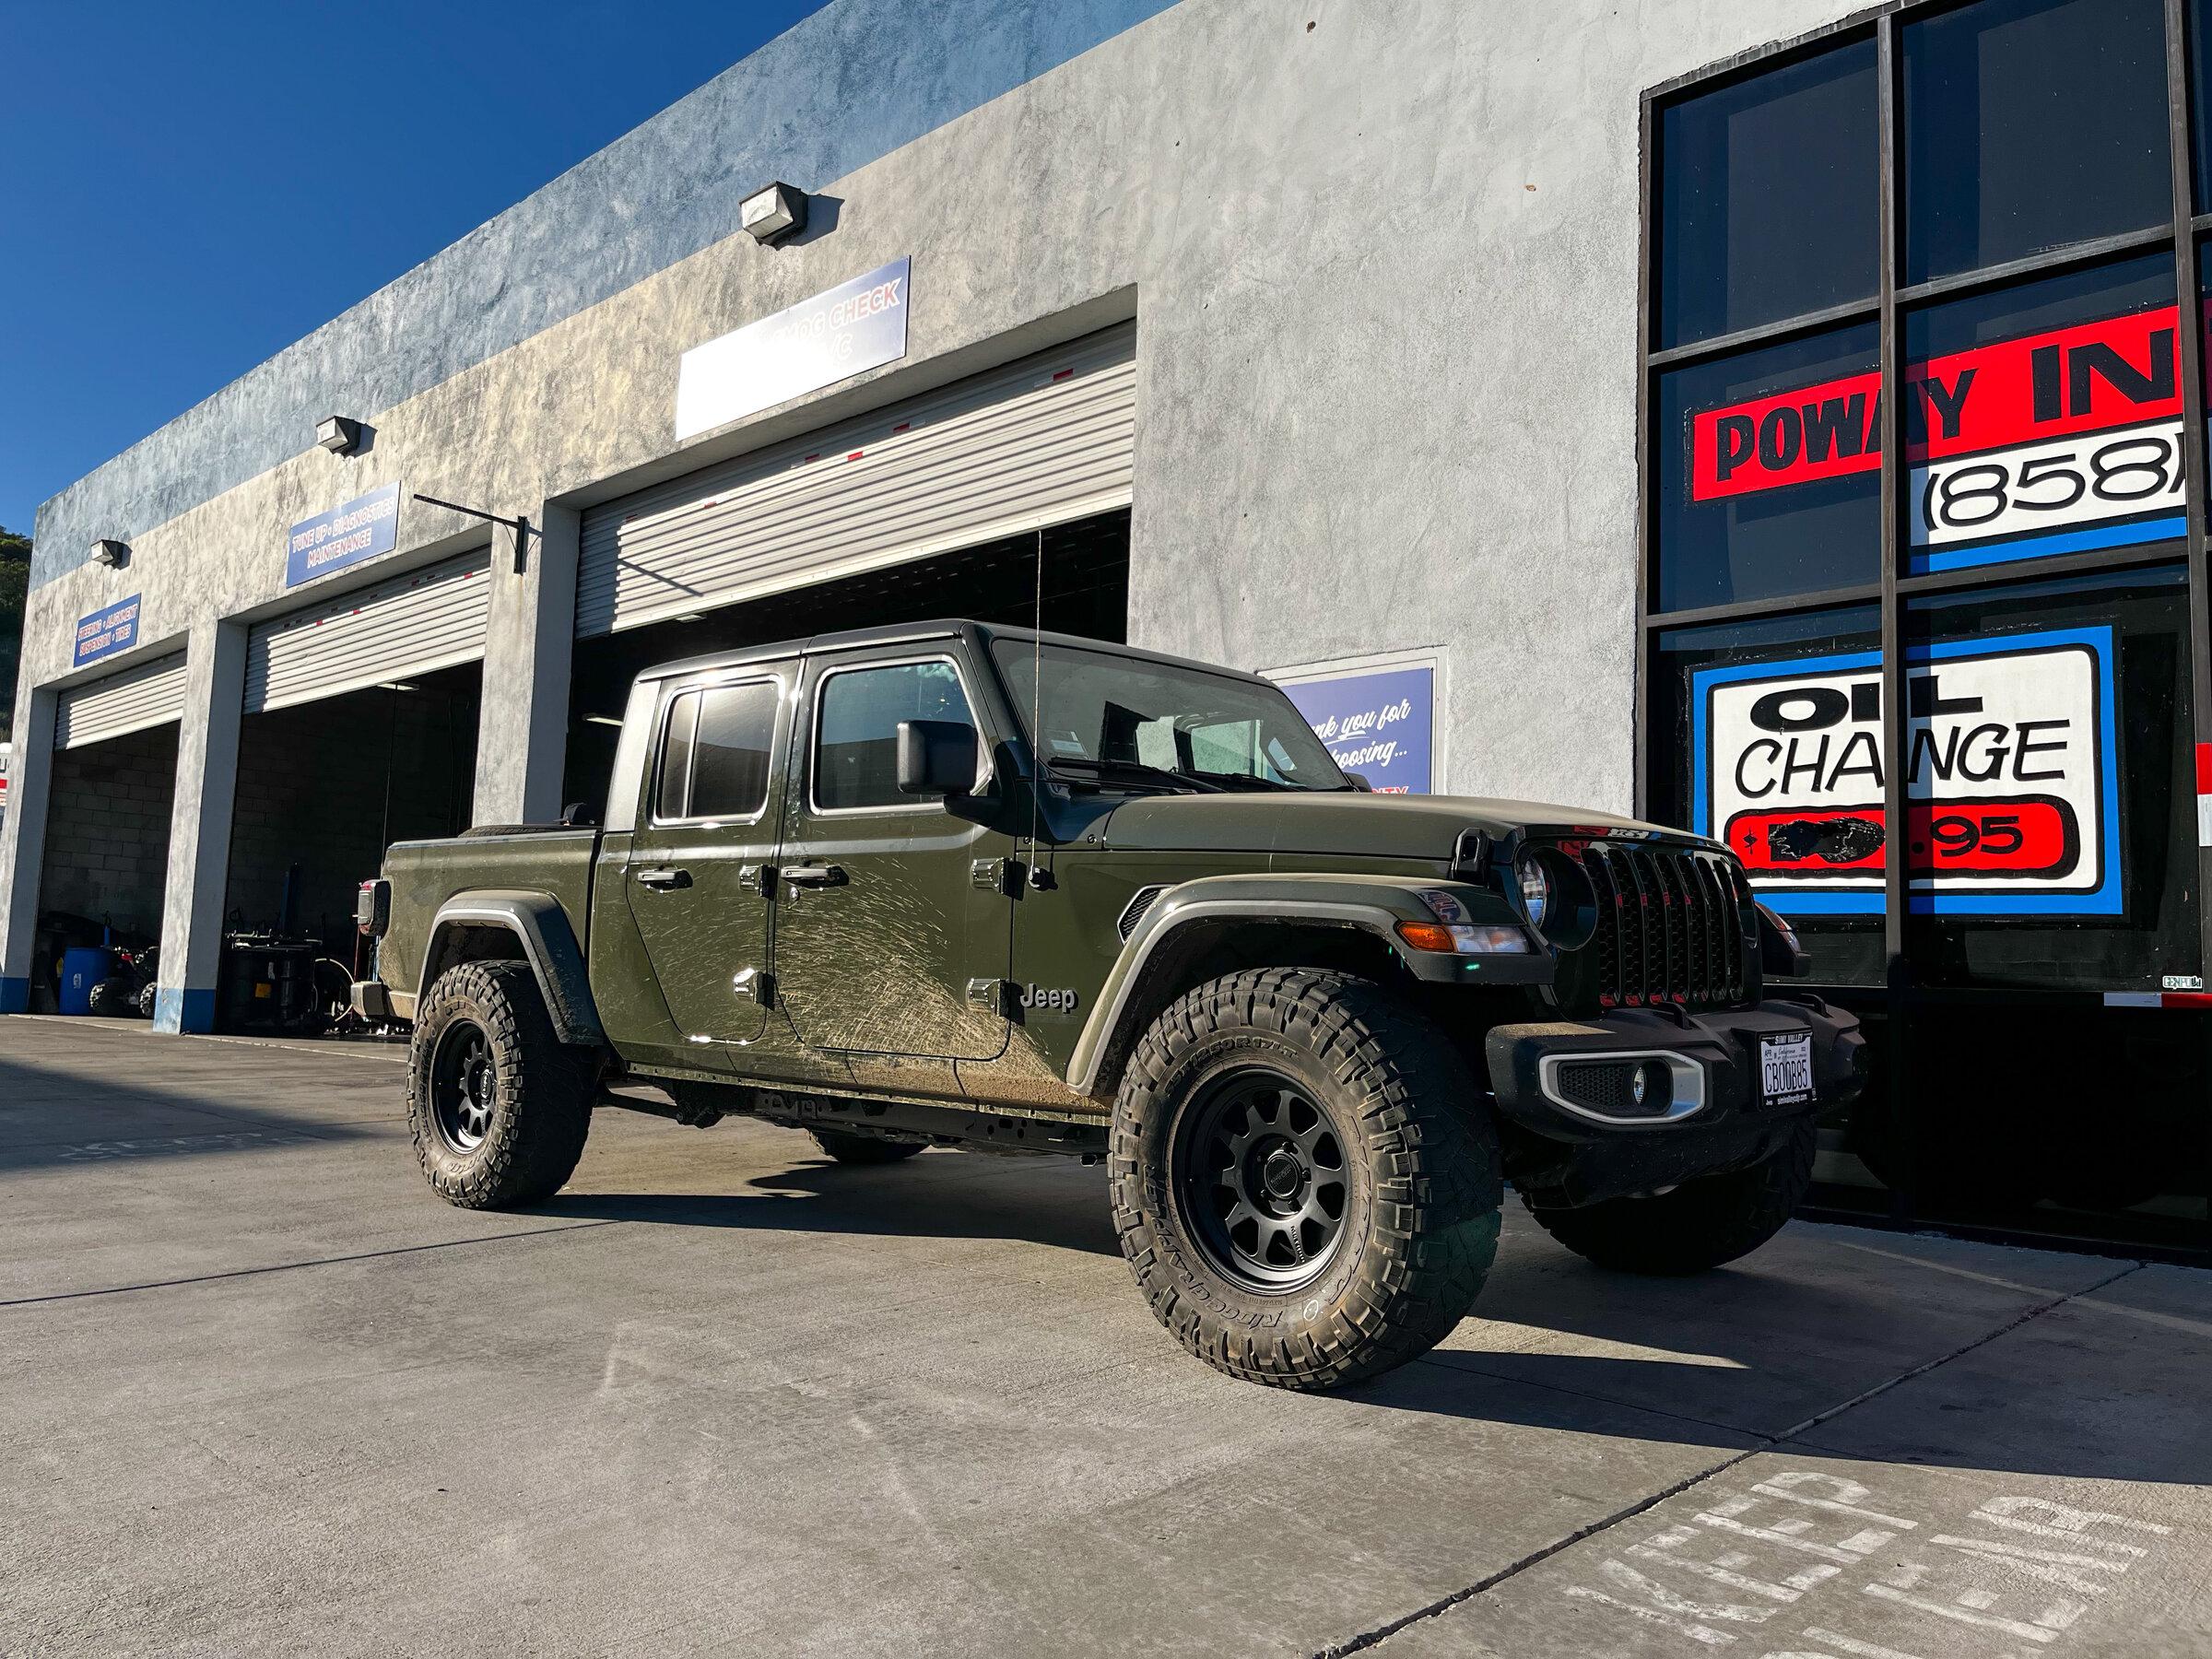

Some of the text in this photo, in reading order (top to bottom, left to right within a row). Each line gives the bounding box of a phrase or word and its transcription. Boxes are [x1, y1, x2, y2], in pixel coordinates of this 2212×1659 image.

[830, 277, 902, 331] CHECK
[1716, 319, 2212, 482] POWAY IN
[1923, 428, 2186, 531] (858)
[292, 496, 394, 553] TUNE UP DIAGNOSTICS
[307, 527, 372, 569] MAINTENANCE
[1338, 711, 1377, 740] you
[1377, 699, 1411, 730] for
[1750, 675, 1983, 733] OIL
[1330, 740, 1407, 769] oosing...
[1735, 719, 2070, 798] CHANGE
[1020, 983, 1076, 1013] Jeep
[1788, 1033, 1804, 1043] VALLEY
[1565, 1472, 1919, 1645] KEEP
